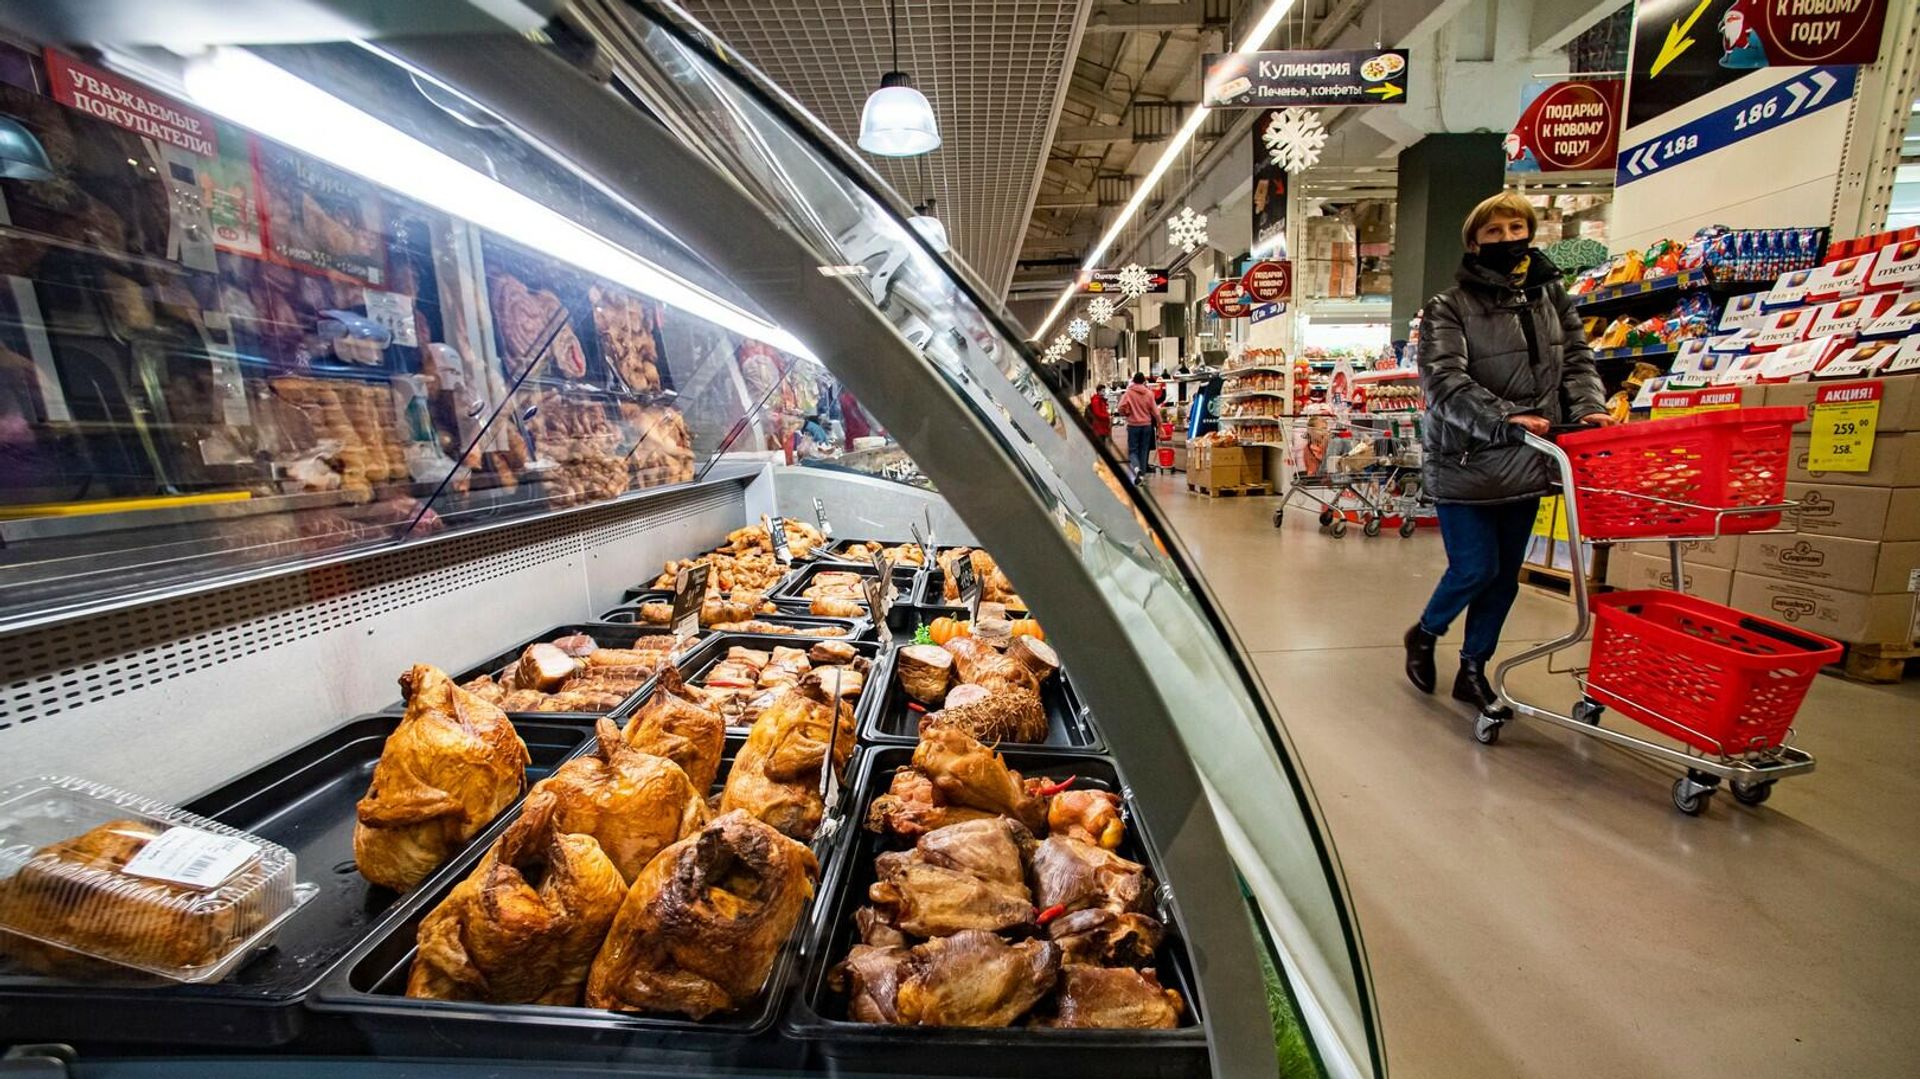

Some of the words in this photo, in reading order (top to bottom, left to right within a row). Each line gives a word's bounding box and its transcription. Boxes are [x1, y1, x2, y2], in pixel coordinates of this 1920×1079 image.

[1790, 21, 1841, 45] ГОДУ!
[1258, 60, 1350, 79] Кулинария
[1258, 85, 1310, 98] Печенье,
[1311, 84, 1363, 97] конфеты
[67, 68, 202, 135] УВАЖАЕМЫЕ
[1544, 102, 1604, 121] ПОДАРКИ
[73, 91, 213, 156] ПОКУПАТЕЛИ!
[1542, 123, 1552, 137] К
[1553, 120, 1604, 137] НОВОМУ
[1553, 139, 1590, 157] ГОДУ!
[1658, 396, 1689, 407] АКЦИЯ!
[1699, 392, 1736, 405] АКЦИЯ!
[1824, 387, 1874, 402] АКЦИЯ!
